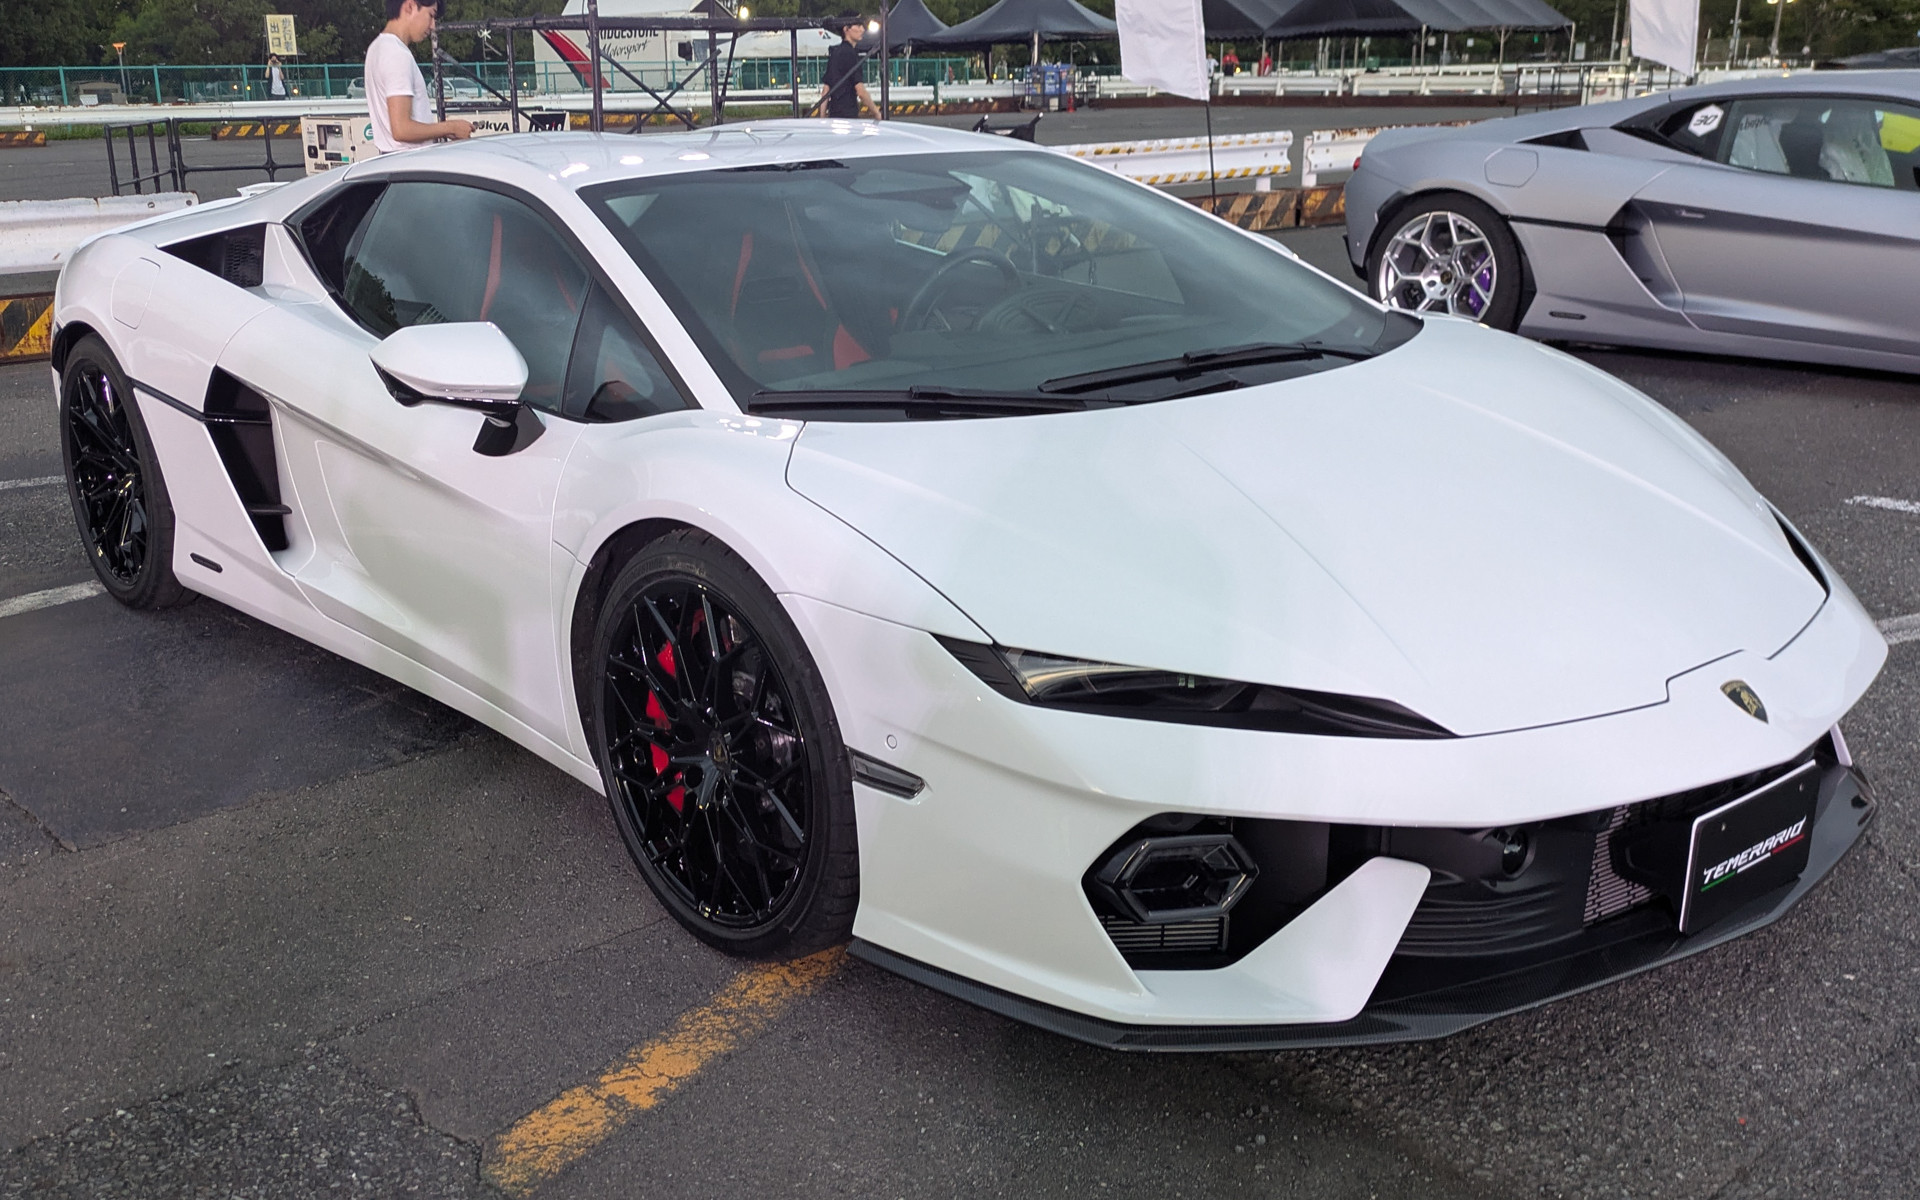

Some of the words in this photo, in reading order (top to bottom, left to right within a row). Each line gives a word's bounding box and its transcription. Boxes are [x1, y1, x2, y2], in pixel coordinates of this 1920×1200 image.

[270, 21, 281, 48] 出口
[599, 29, 659, 40] IDGESTONE
[1703, 816, 1807, 885] TEMERARIO
